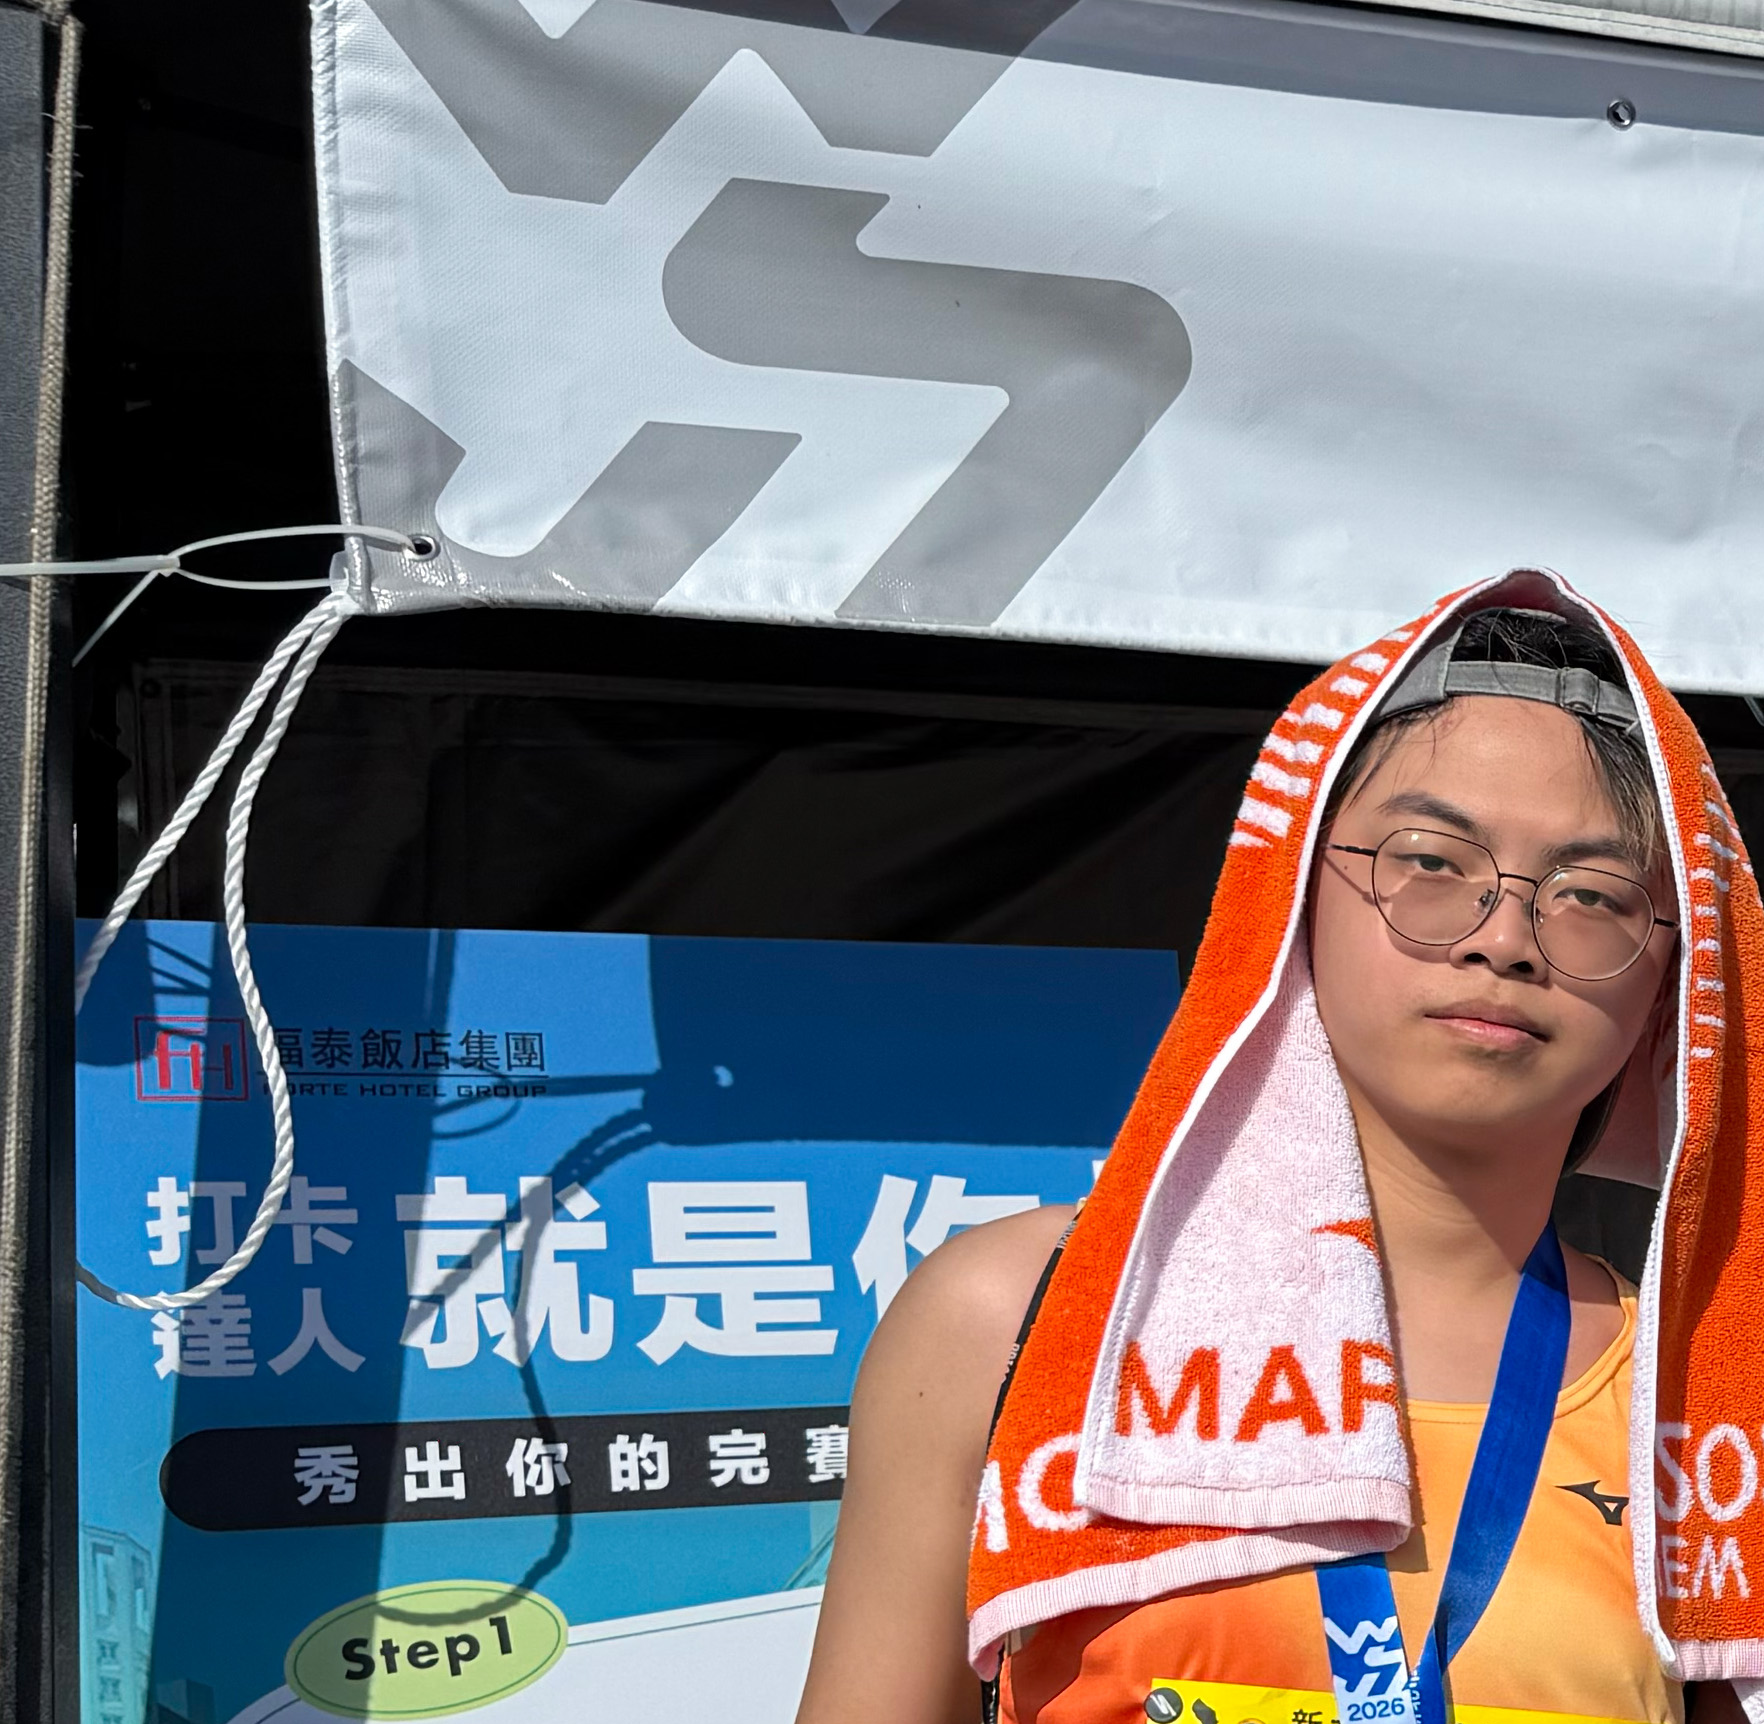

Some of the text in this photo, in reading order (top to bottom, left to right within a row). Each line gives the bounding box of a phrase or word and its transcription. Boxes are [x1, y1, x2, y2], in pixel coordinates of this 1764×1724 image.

[359, 1082, 447, 1098] HOTEL
[456, 1082, 548, 1099] GROUP
[146, 1175, 359, 1266] 打卡
[151, 1287, 367, 1380] 達人
[340, 1614, 516, 1683] Step1
[1347, 1697, 1406, 1722] 2026
